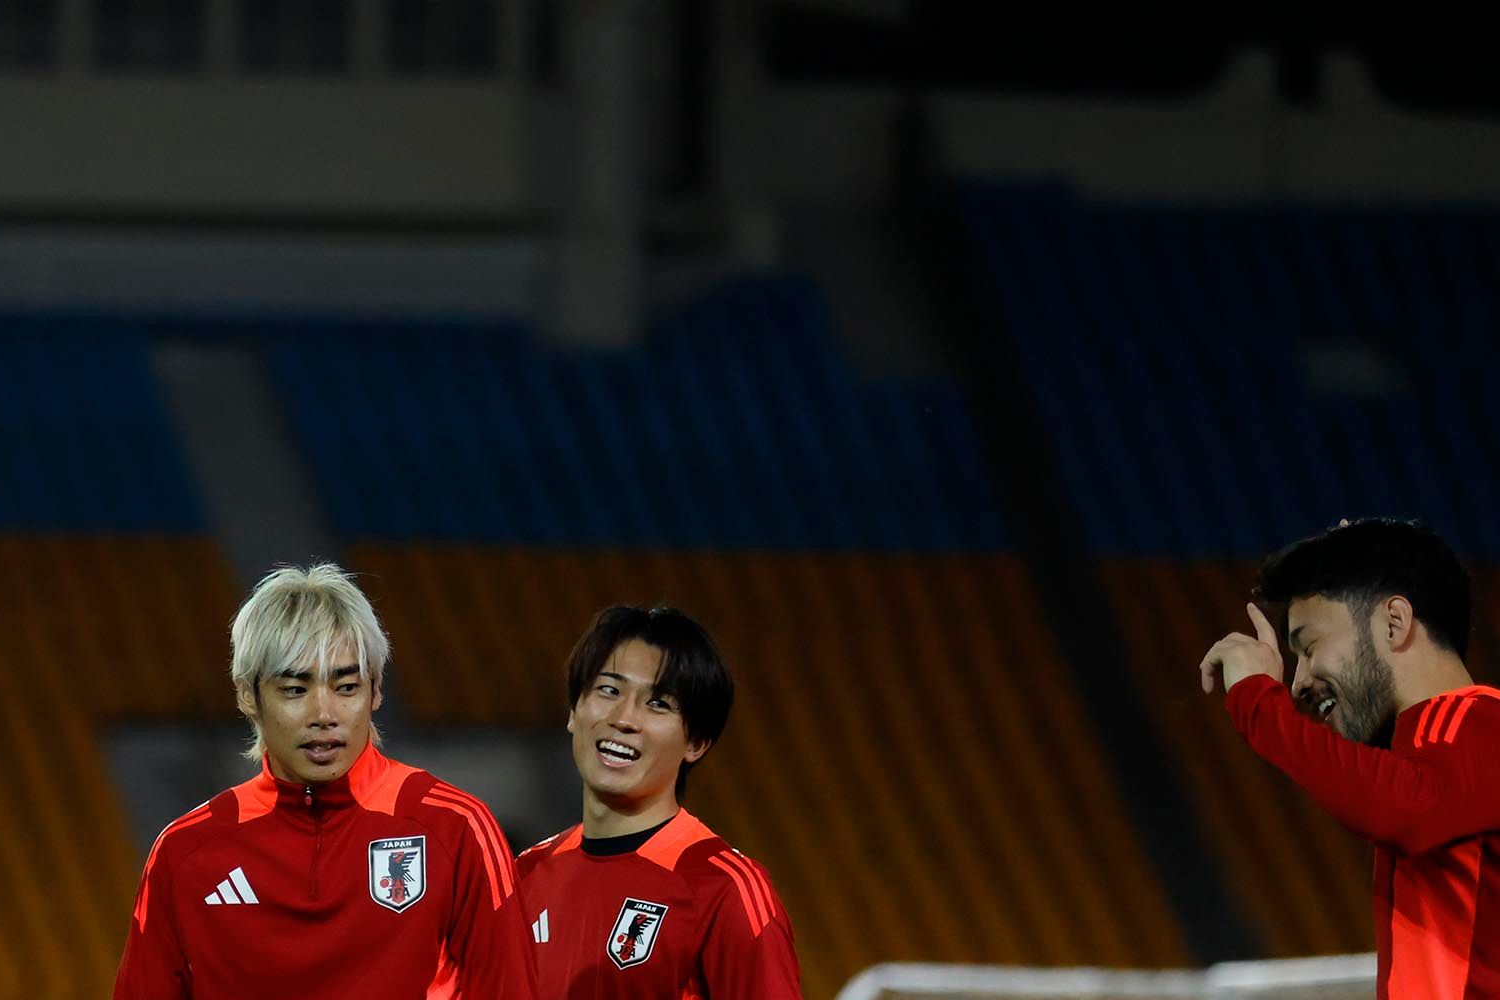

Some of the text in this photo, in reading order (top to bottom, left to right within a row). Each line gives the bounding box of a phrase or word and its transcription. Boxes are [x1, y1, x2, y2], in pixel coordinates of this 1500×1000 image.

[382, 840, 412, 849] JAPAN
[386, 887, 411, 900] JFA
[634, 902, 657, 913] JAPAN
[615, 944, 636, 958] JFA
